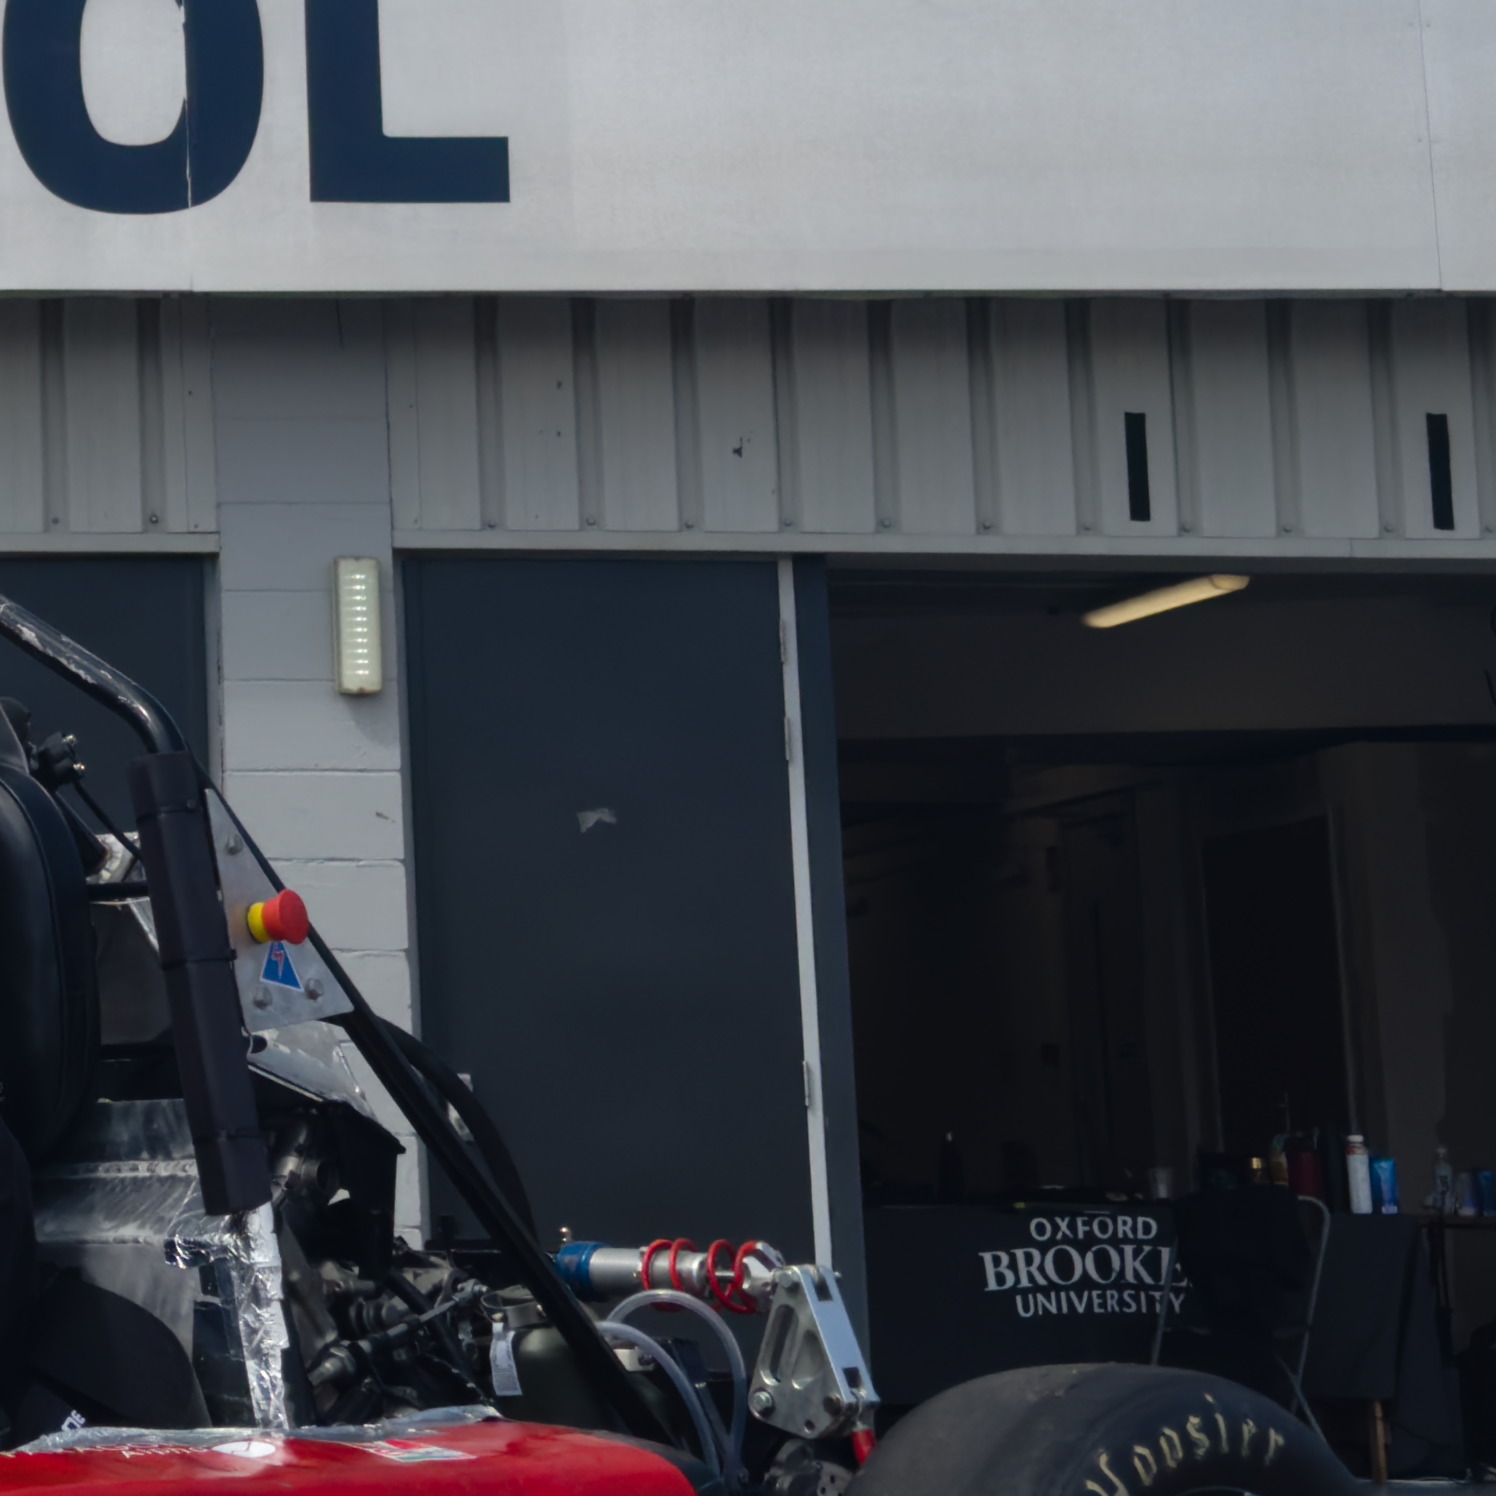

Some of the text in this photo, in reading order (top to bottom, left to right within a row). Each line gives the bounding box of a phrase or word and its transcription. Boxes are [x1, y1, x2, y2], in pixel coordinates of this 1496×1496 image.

[1029, 1215, 1158, 1242] OXFORD
[978, 1243, 1193, 1292] BROOKE
[1015, 1289, 1185, 1318] UNIVERSITY
